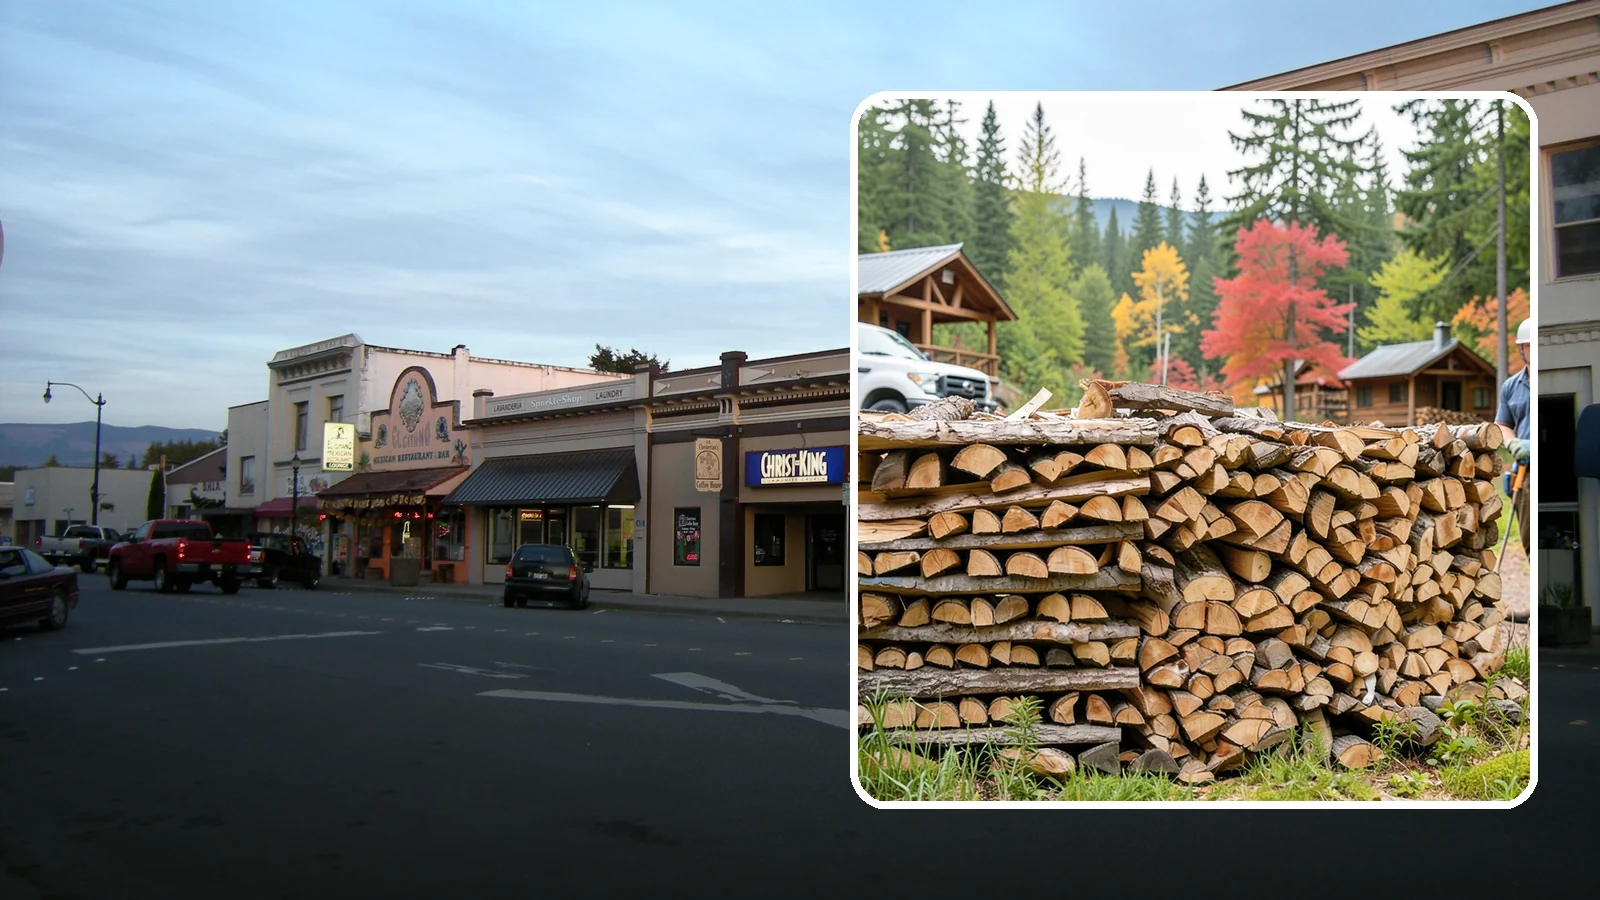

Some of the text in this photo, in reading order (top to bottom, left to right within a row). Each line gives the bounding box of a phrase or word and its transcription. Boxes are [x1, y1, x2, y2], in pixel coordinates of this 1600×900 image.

[562, 394, 582, 405] Shop
[595, 389, 623, 400] LAUNDRY
[373, 455, 396, 465] MEXICAN
[397, 451, 434, 463] RESTAURANT
[438, 450, 450, 459] BAR
[760, 450, 827, 478] CHRIST KING
